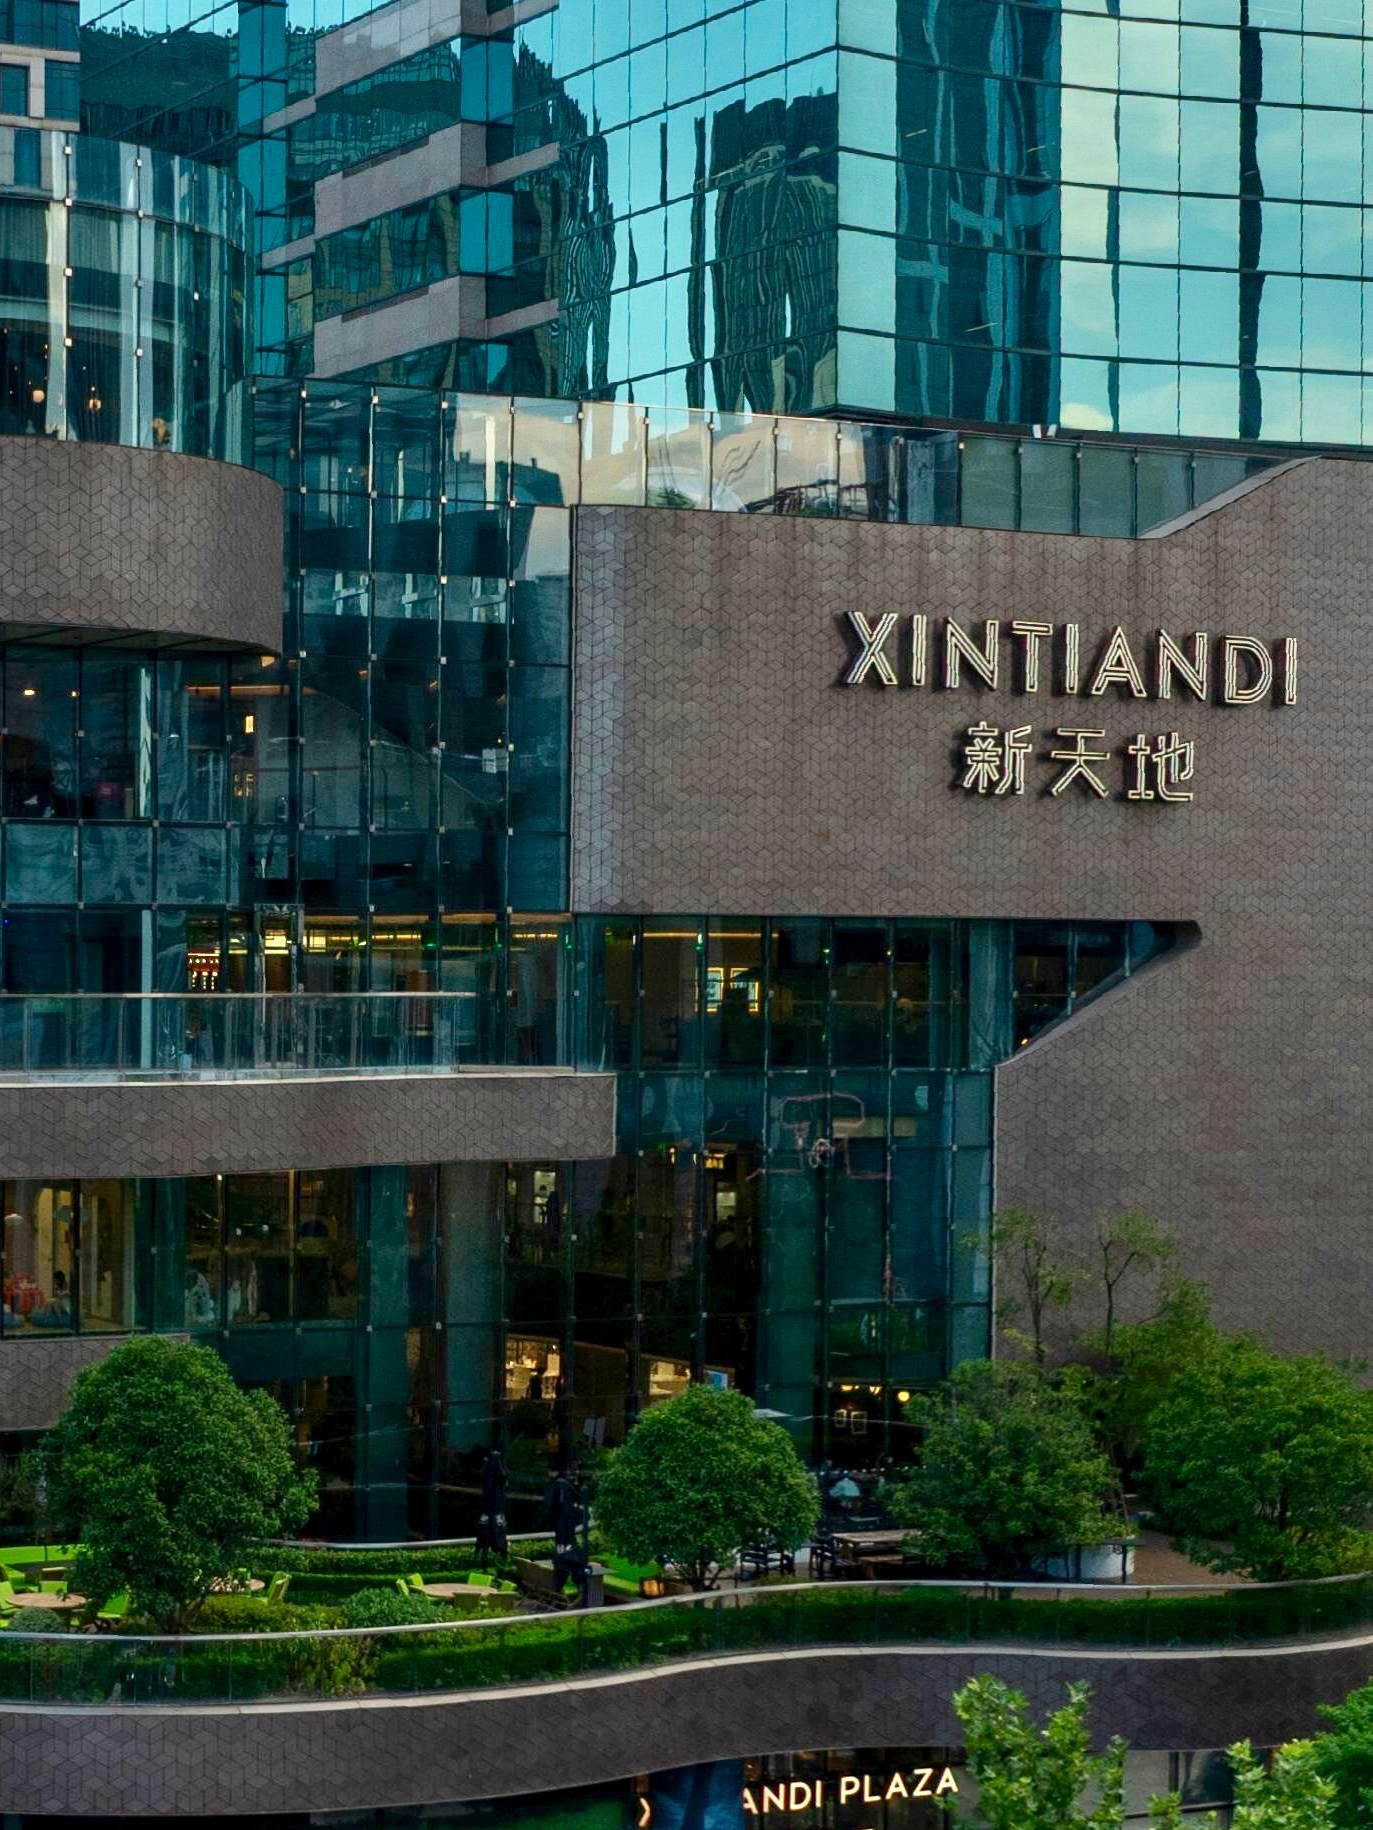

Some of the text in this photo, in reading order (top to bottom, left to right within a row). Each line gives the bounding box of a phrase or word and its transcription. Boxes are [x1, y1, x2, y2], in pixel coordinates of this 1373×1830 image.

[841, 610, 1298, 705] XINTIANDI
[962, 721, 1195, 802] 新天地
[840, 1767, 959, 1804] PLAZA
